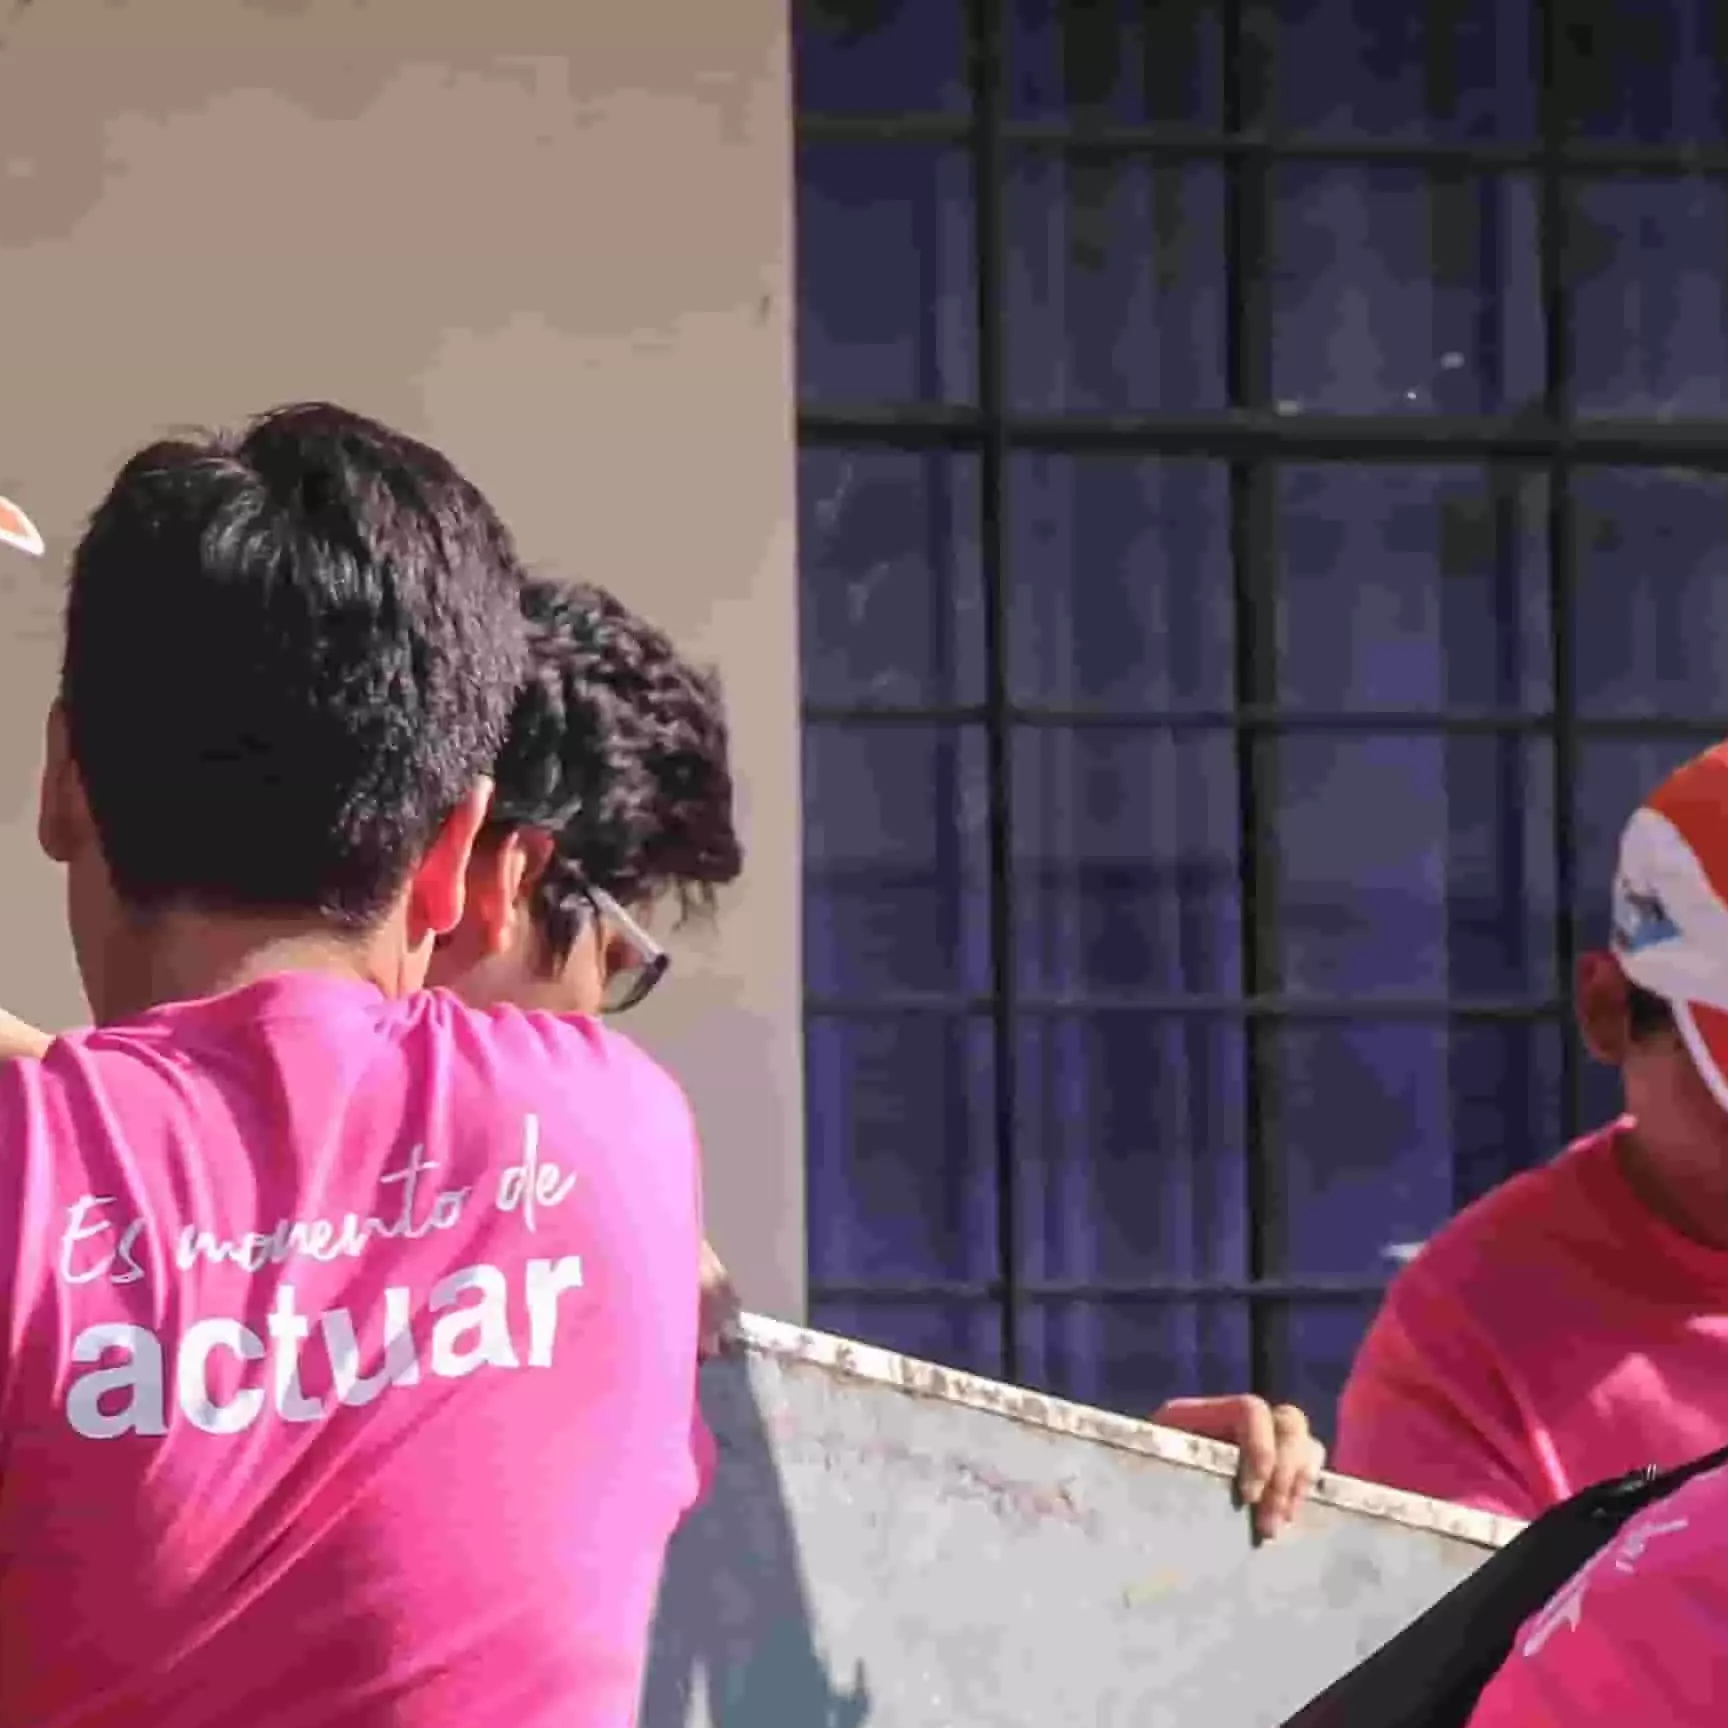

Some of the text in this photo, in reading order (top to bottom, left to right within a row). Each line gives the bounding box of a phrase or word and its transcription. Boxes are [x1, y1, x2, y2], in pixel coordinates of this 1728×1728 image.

[59, 1113, 577, 1285] Es momento de
[65, 1254, 585, 1441] actuar
